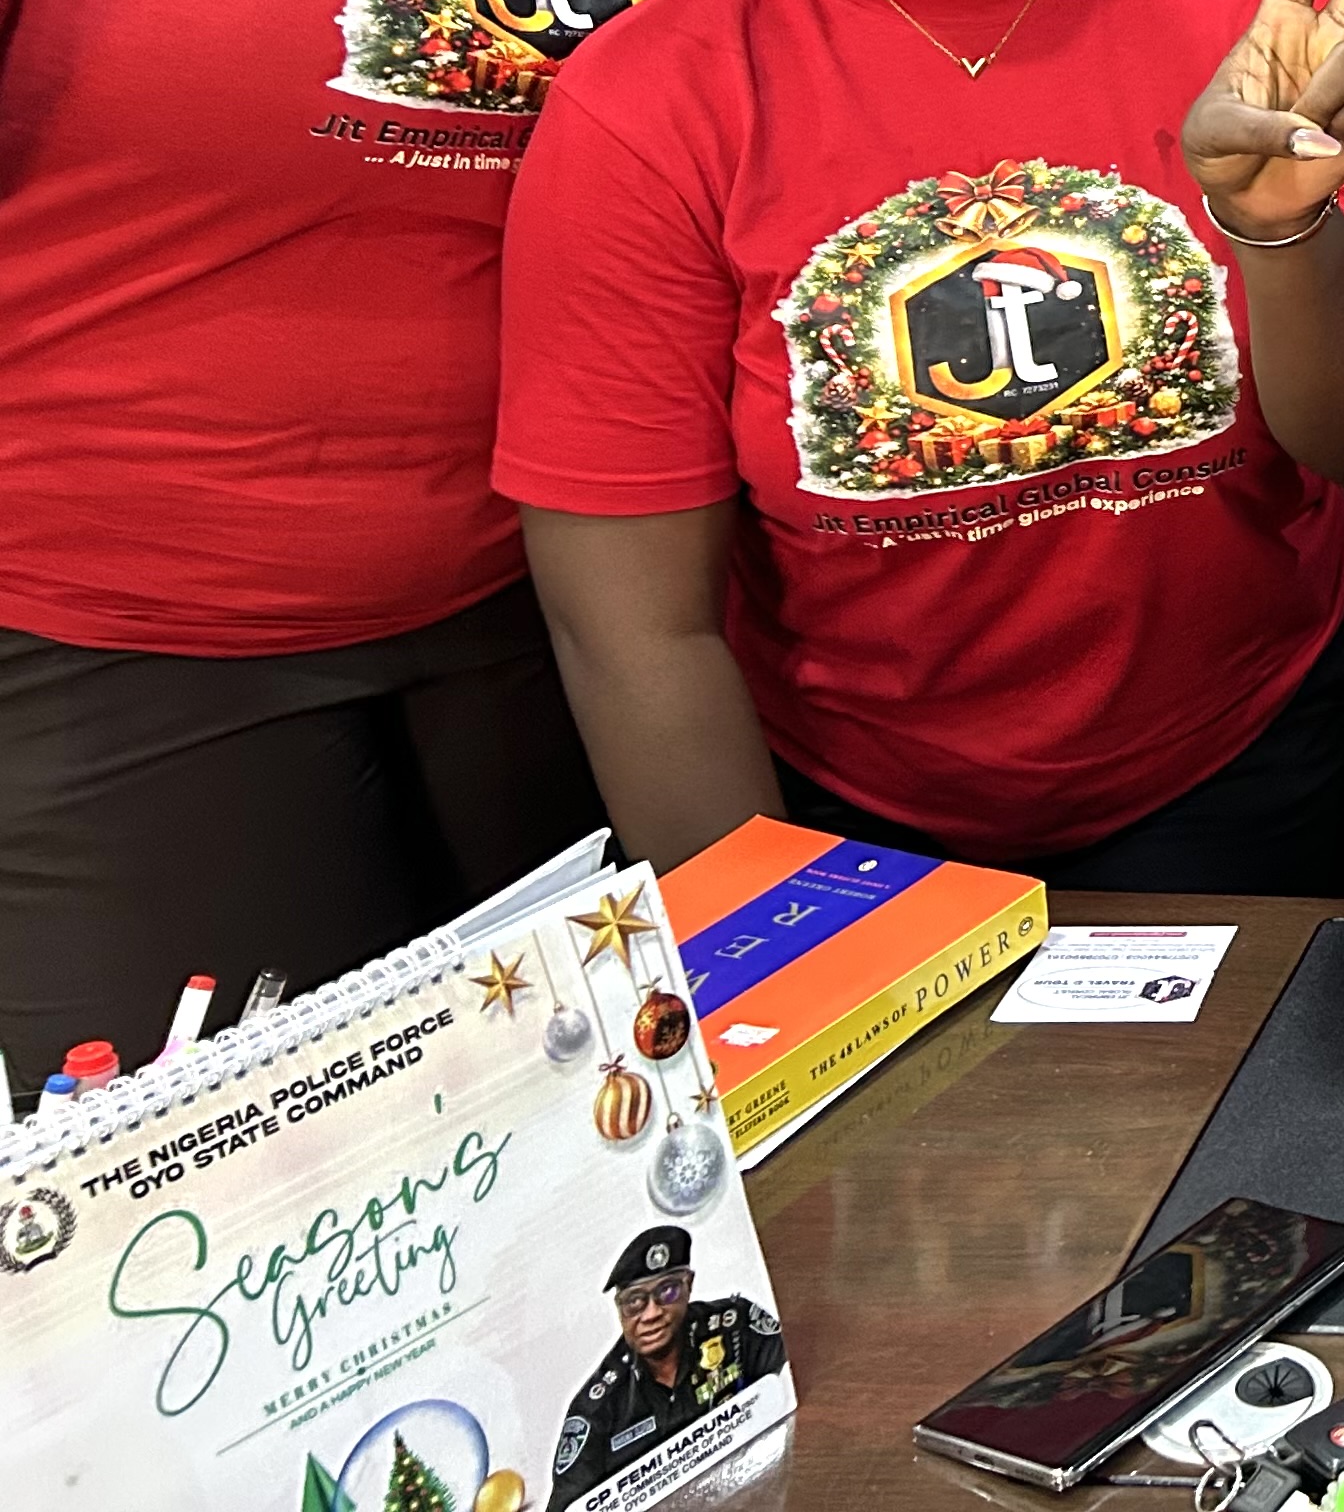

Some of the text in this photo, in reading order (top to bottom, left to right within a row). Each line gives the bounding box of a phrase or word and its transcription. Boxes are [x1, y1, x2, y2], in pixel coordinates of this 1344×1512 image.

[309, 113, 511, 151] Jit Empirical
[389, 150, 511, 171] A just in time
[853, 445, 1248, 537] Empirical Global Consult
[967, 517, 1013, 544] time
[1018, 496, 1088, 527] global
[1090, 485, 1205, 516] experience
[809, 1051, 838, 1081] THE
[854, 1018, 891, 1049] LAWS
[891, 1004, 909, 1023] OF
[915, 931, 1011, 1014] POWER
[80, 1007, 454, 1199] THE NIGERIA POLICE FORCE
[130, 1046, 425, 1200] OYO STATE COMMAND
[743, 1078, 788, 1114] GREENE
[109, 1093, 514, 1417] Season's
[271, 1216, 460, 1370] Greeting
[263, 1302, 452, 1418] MERRY CHRISTMAS
[290, 1406, 319, 1430] AND
[331, 1375, 372, 1405] HAPPY
[372, 1359, 402, 1383] NEW
[402, 1337, 437, 1362] YEAR
[585, 1489, 613, 1512] CP
[615, 1453, 665, 1493] FEMI
[665, 1402, 743, 1460] HARUNA
[599, 1410, 754, 1512] THE COMMISSIONER OF POLICE
[624, 1493, 648, 1512] OYO
[649, 1468, 681, 1497] STATE
[681, 1433, 735, 1475] COMMAND
